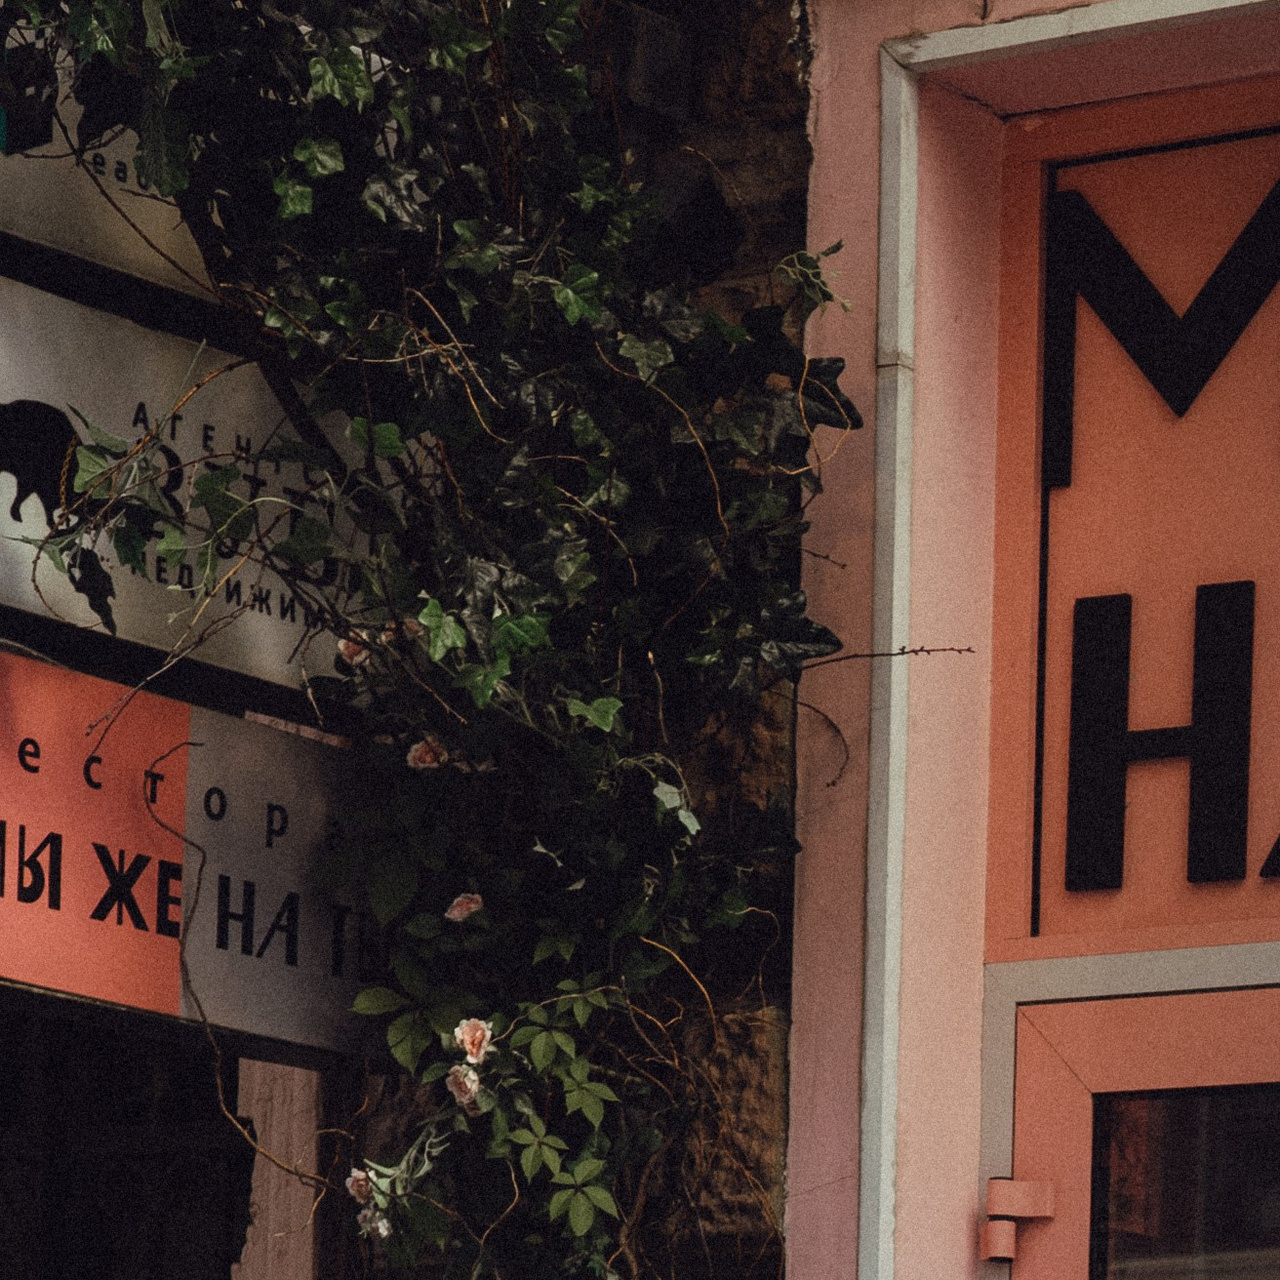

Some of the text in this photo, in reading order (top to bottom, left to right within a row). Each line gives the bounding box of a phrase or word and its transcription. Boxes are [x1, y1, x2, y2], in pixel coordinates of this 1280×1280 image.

[0, 820, 62, 911] Ы
[90, 842, 182, 939] ЖЕ
[216, 874, 299, 967] НА
